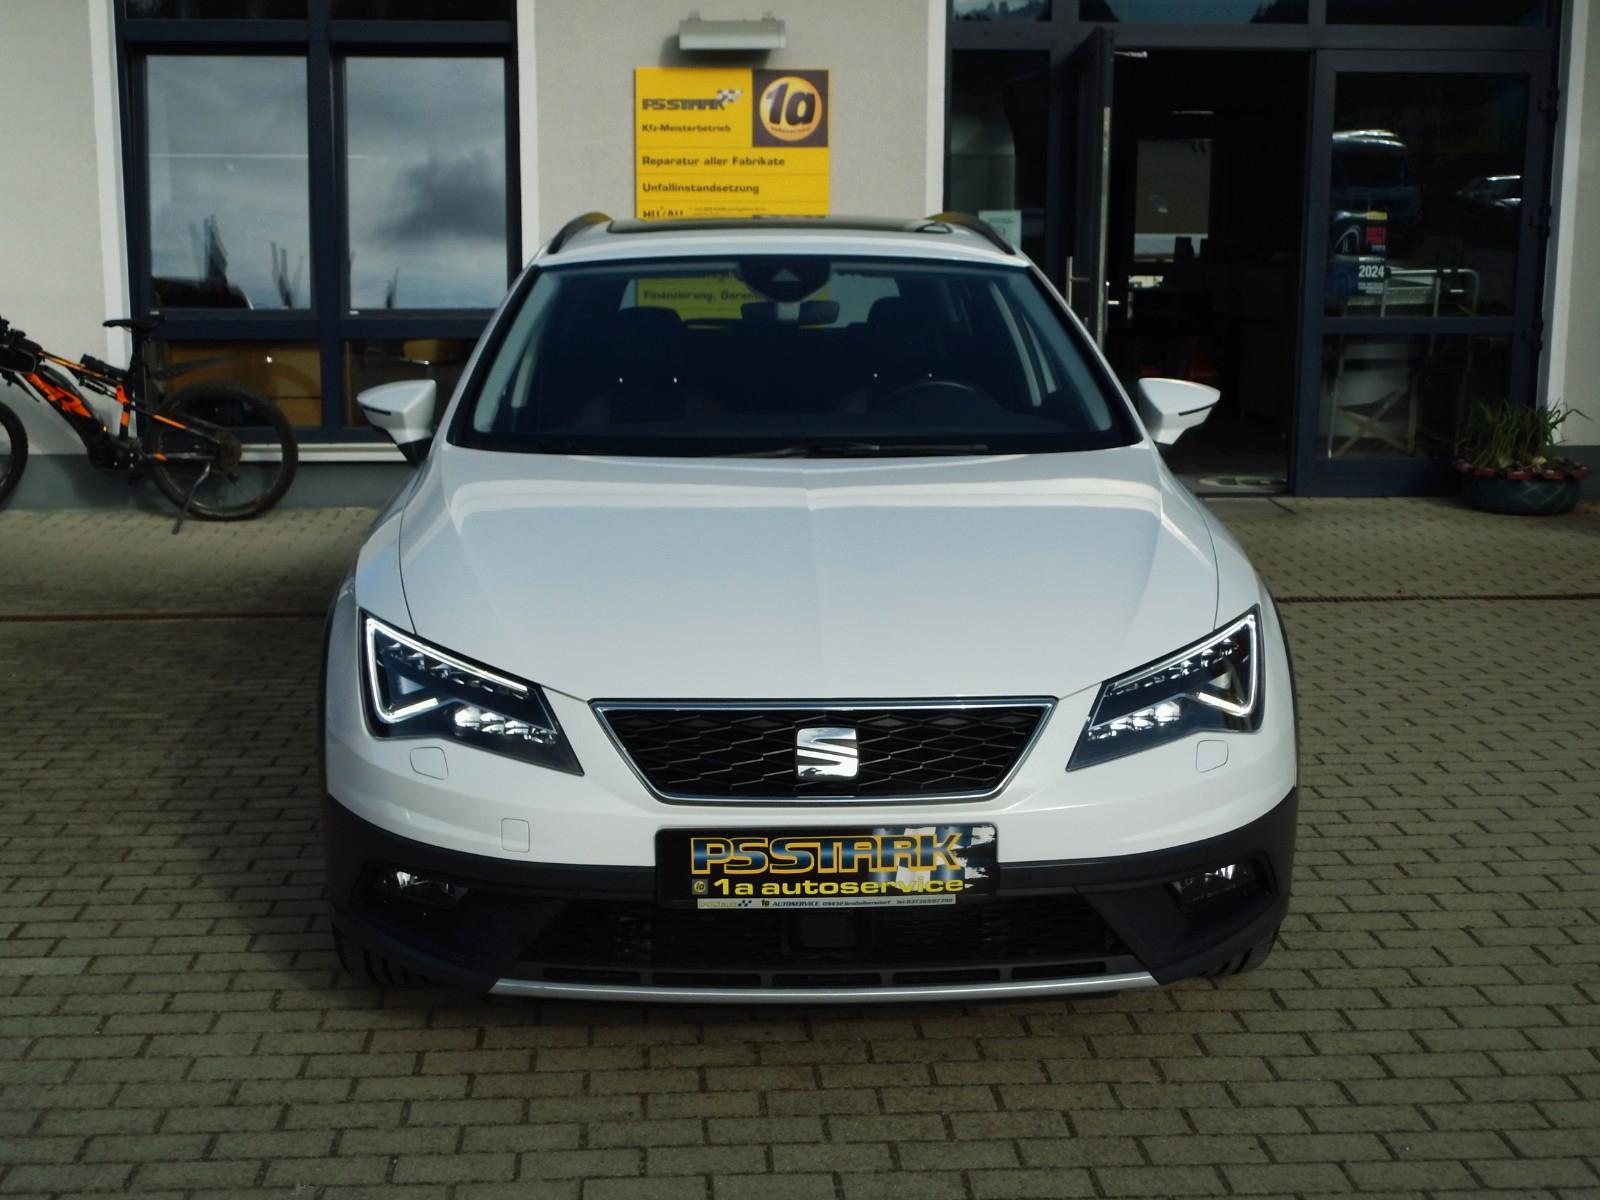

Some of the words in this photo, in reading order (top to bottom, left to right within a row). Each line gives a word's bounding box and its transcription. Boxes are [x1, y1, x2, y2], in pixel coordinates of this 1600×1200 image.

[766, 82, 816, 126] 1a
[642, 124, 731, 133] Kfz-Meisterbetrieb
[642, 156, 699, 167] Reparatur
[704, 156, 728, 166] aller
[732, 156, 785, 166] Fabrikate
[642, 183, 760, 195] Unfallinstandsetzung
[1358, 265, 1385, 278] 2024
[643, 290, 716, 302] Finanzierung,
[690, 834, 962, 875] PSSTARK
[713, 879, 754, 895] 1a
[761, 879, 964, 895] autoservice
